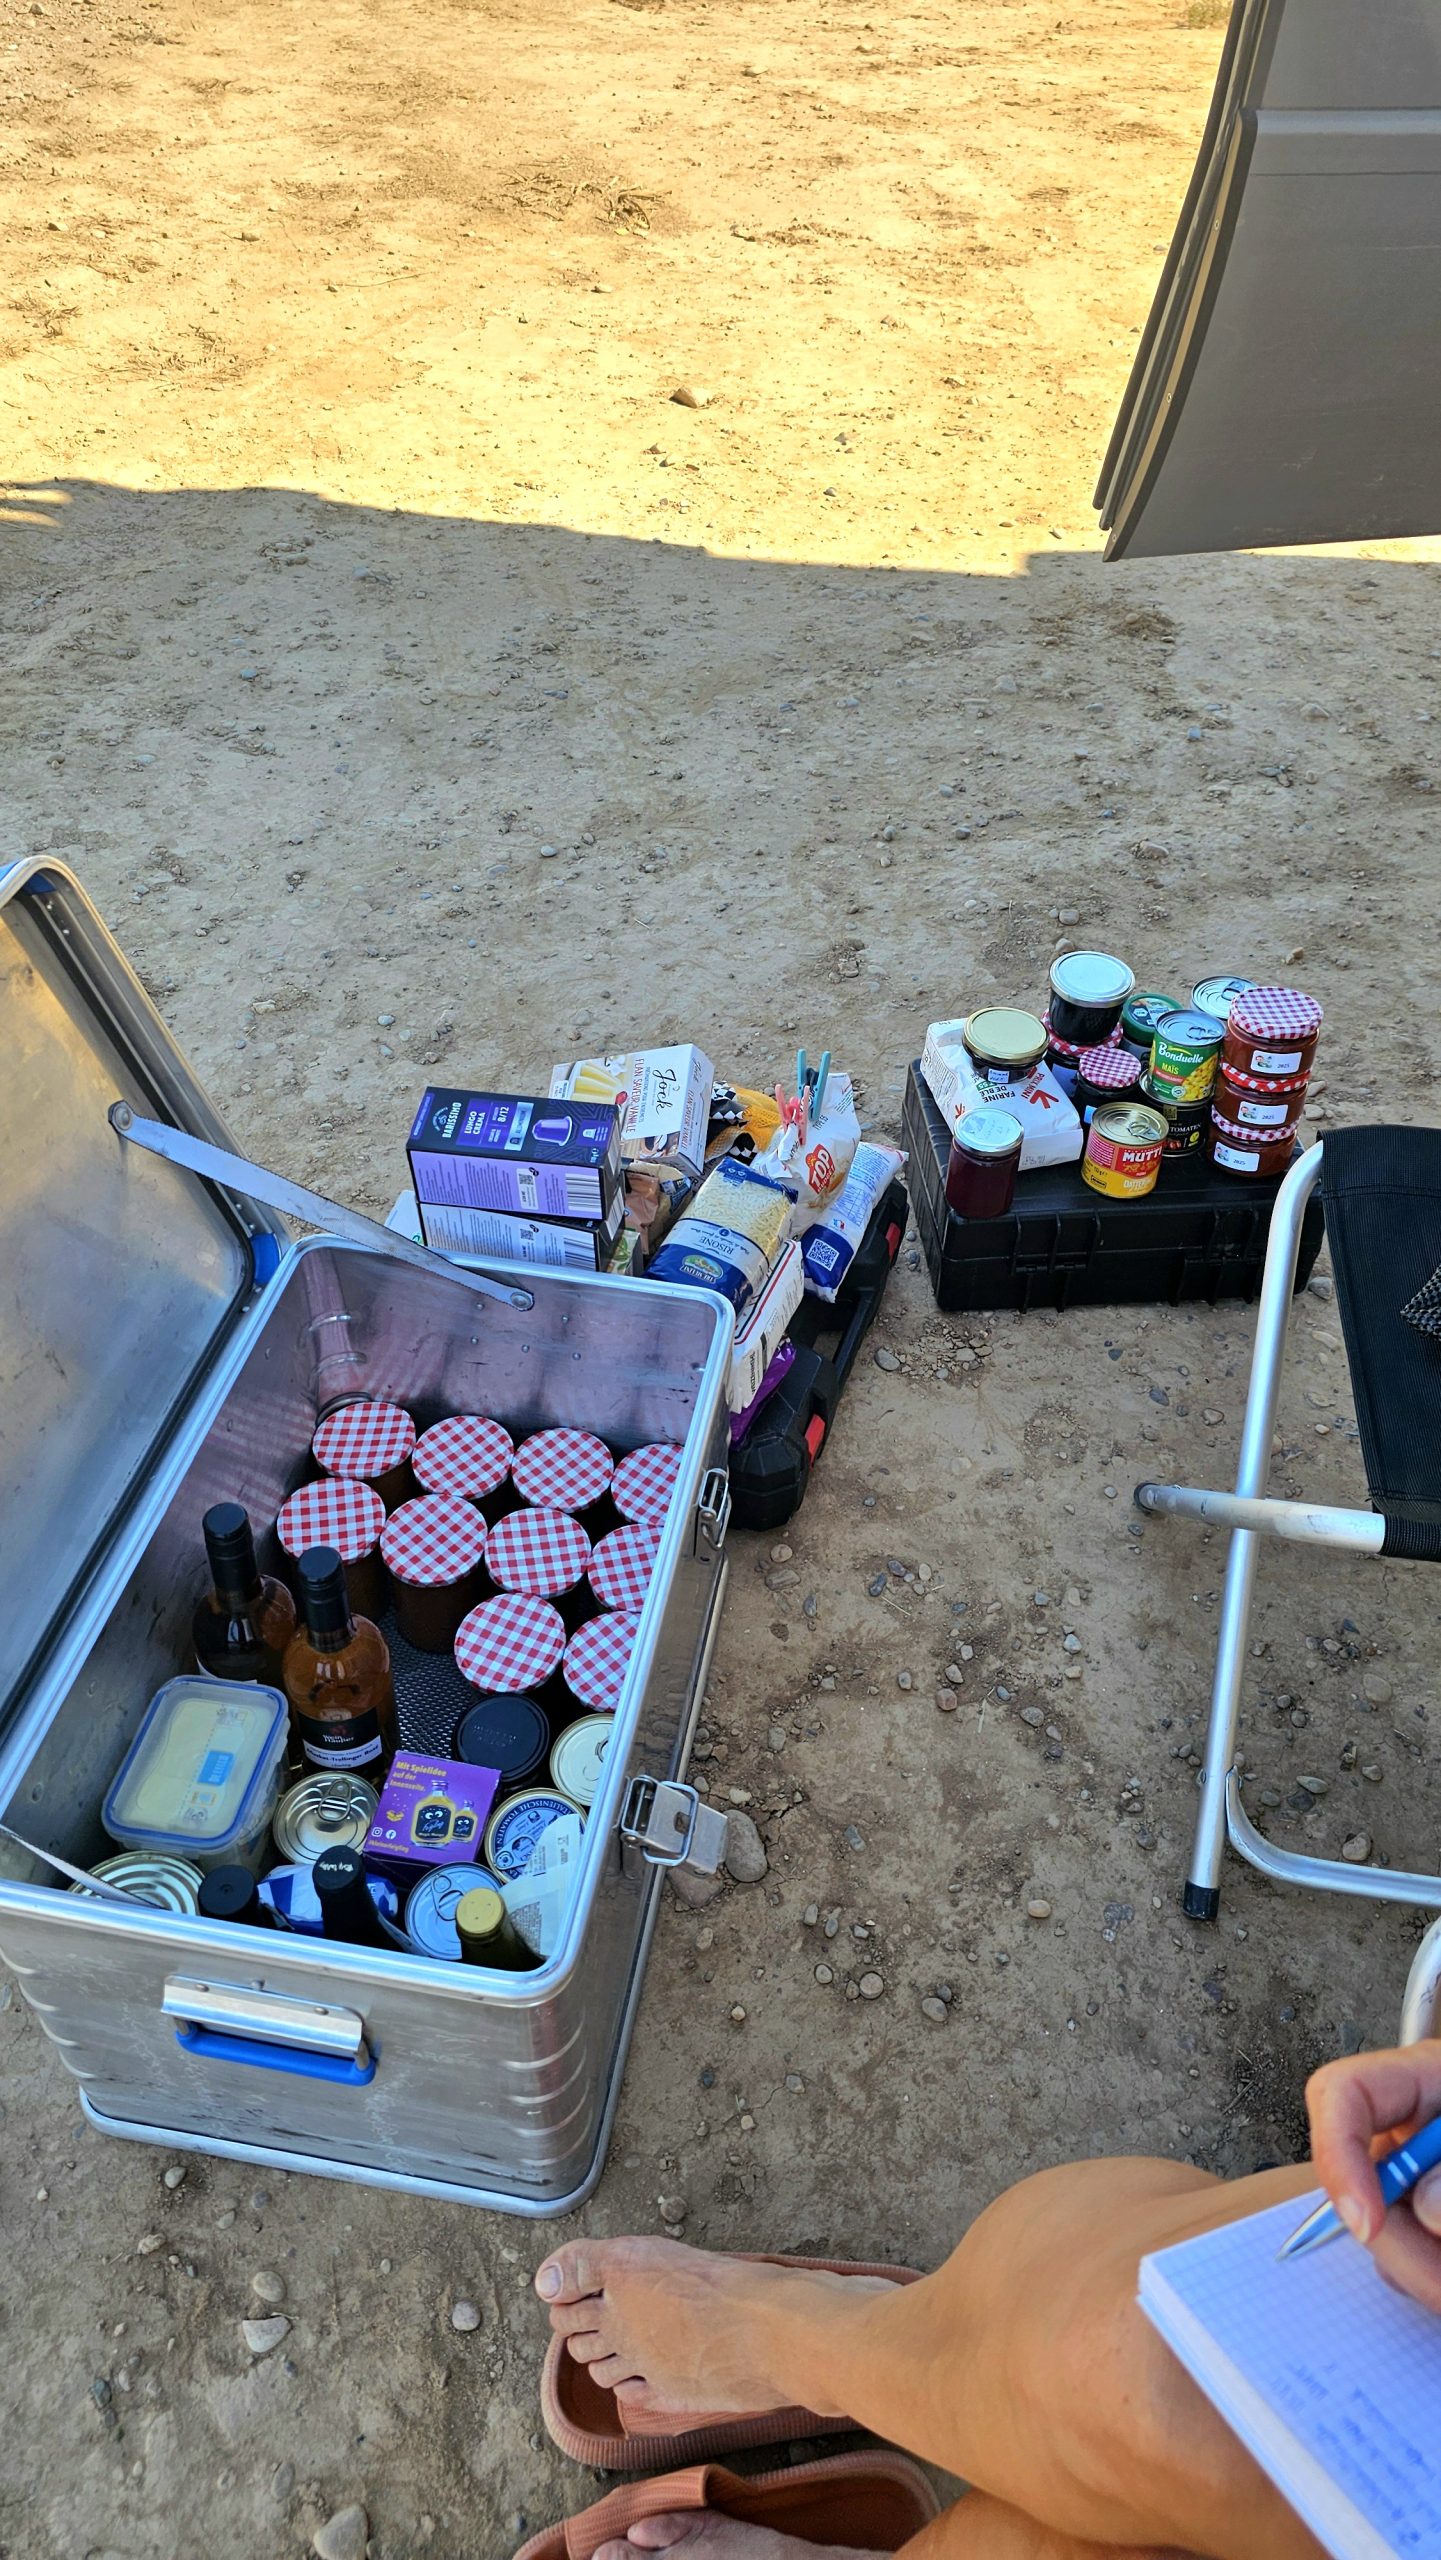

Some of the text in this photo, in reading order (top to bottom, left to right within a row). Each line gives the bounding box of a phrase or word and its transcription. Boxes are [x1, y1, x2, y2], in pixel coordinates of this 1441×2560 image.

[1158, 1042, 1203, 1063] Bonduelle
[1161, 1062, 1179, 1075] MAÏS
[625, 1058, 644, 1133] FLAN SAVEUR VANILLE
[652, 1068, 677, 1115] Jock
[982, 1091, 1016, 1103] FARINE
[441, 1102, 462, 1138] BARISSIMO
[464, 1111, 477, 1135] LUNGO
[472, 1112, 486, 1135] CREMA
[497, 1106, 510, 1123] 8/12
[1122, 1145, 1163, 1162] MUTTI
[811, 1149, 830, 1188] TOP
[700, 1236, 734, 1255] RISONE
[396, 1761, 447, 1777] Mit Spielidee
[496, 1810, 518, 1845] TOMATEN
